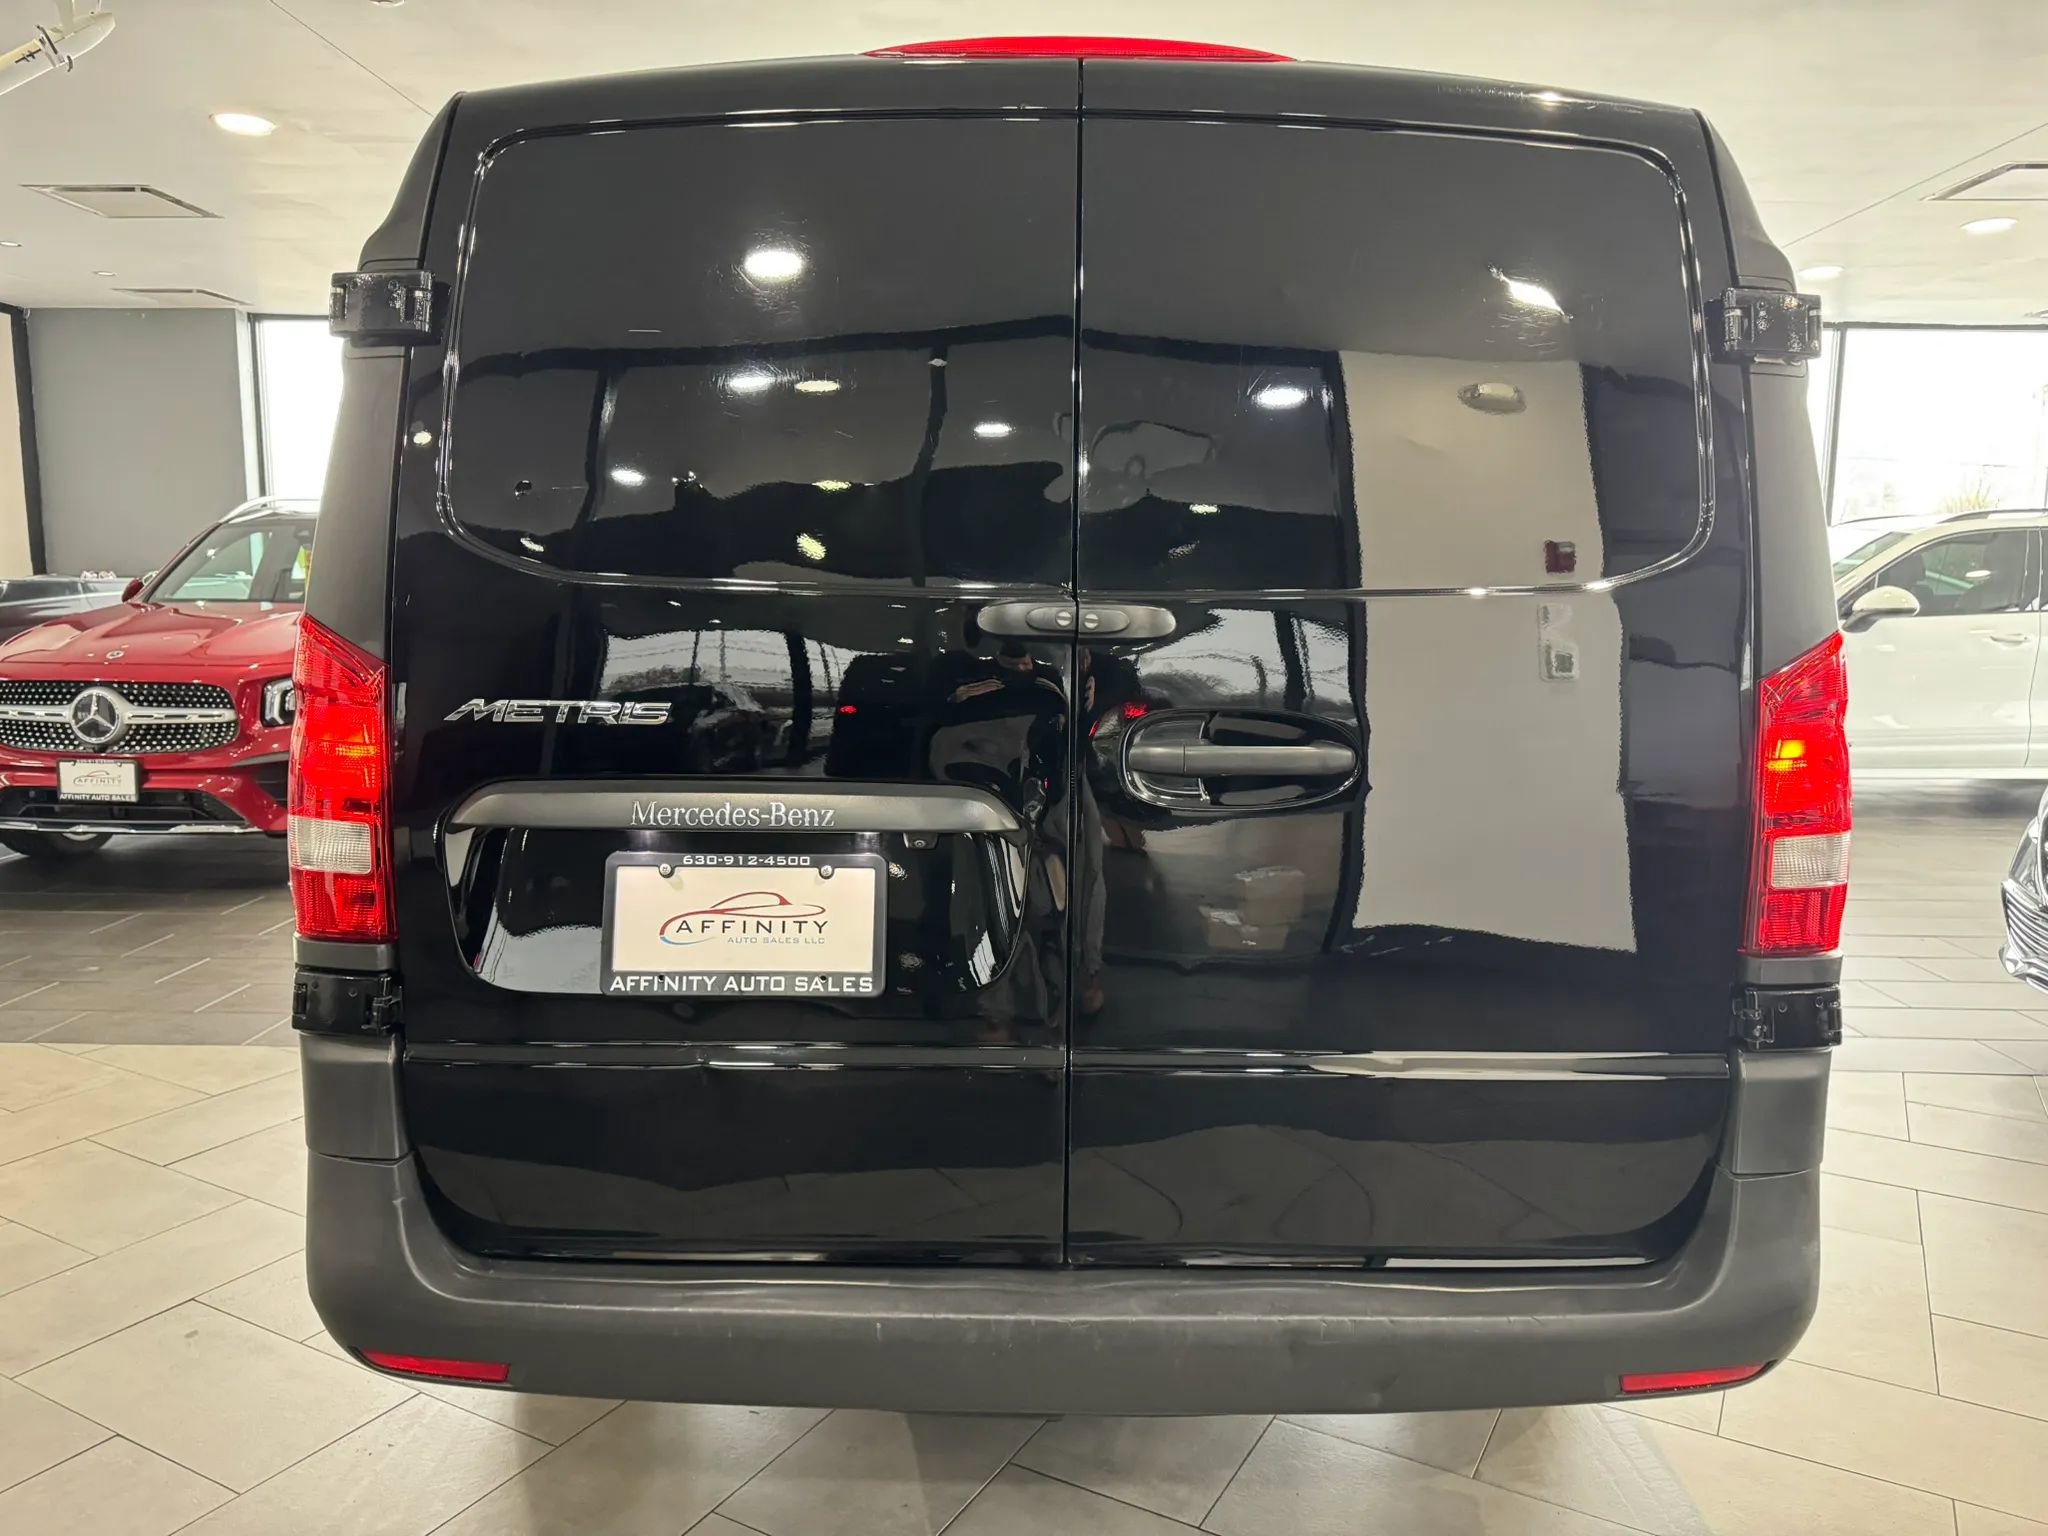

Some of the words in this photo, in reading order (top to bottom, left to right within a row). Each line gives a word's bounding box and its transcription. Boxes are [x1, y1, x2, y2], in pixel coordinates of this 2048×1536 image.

[443, 698, 672, 725] METRIS
[630, 800, 836, 828] Mercedes-Benz
[683, 855, 810, 866] 630-912-4500
[676, 920, 829, 934] AFFINITY
[610, 976, 718, 992] AFFINITY
[723, 976, 786, 992] AUTO
[794, 976, 874, 993] SALES
